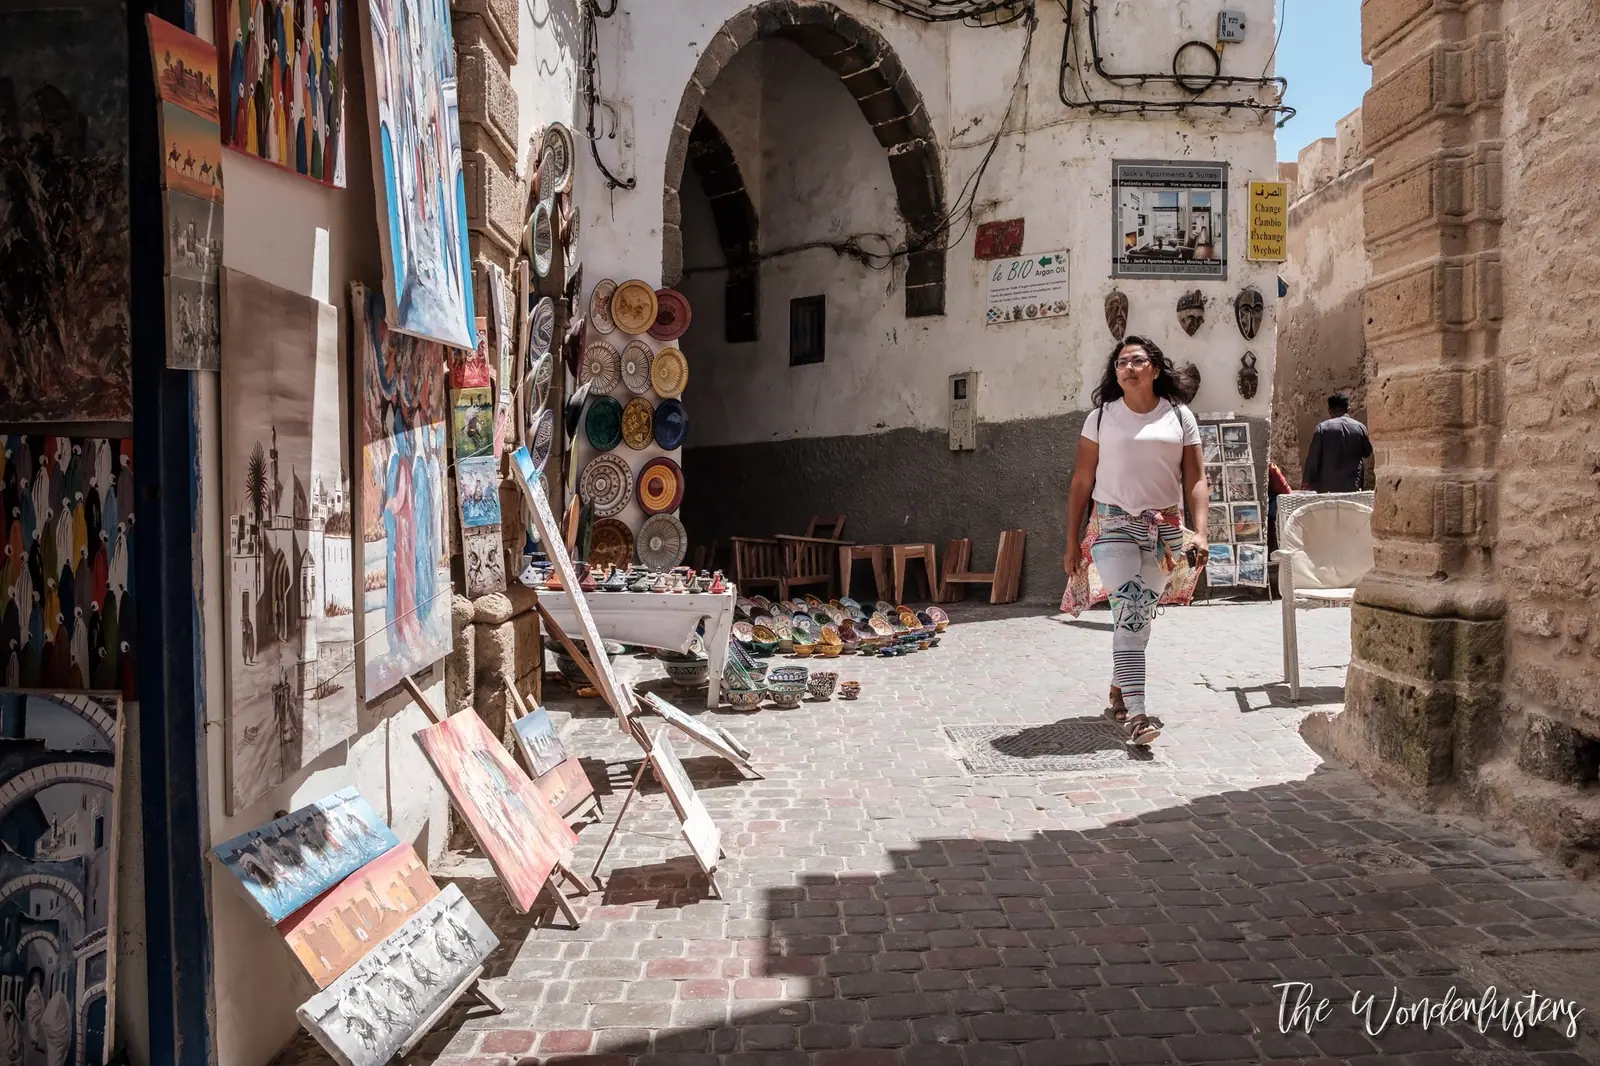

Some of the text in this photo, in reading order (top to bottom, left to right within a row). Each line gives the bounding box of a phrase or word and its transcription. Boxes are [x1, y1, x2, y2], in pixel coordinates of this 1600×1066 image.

[1145, 170, 1185, 178] Apartments
[1255, 185, 1282, 199] الصرف
[1255, 203, 1281, 215] Change
[1254, 216, 1281, 227] Cambio
[1251, 230, 1284, 243] Exchange
[1253, 245, 1281, 256] Wechsel
[992, 259, 1034, 282] le BIO
[1035, 269, 1054, 277] Argan
